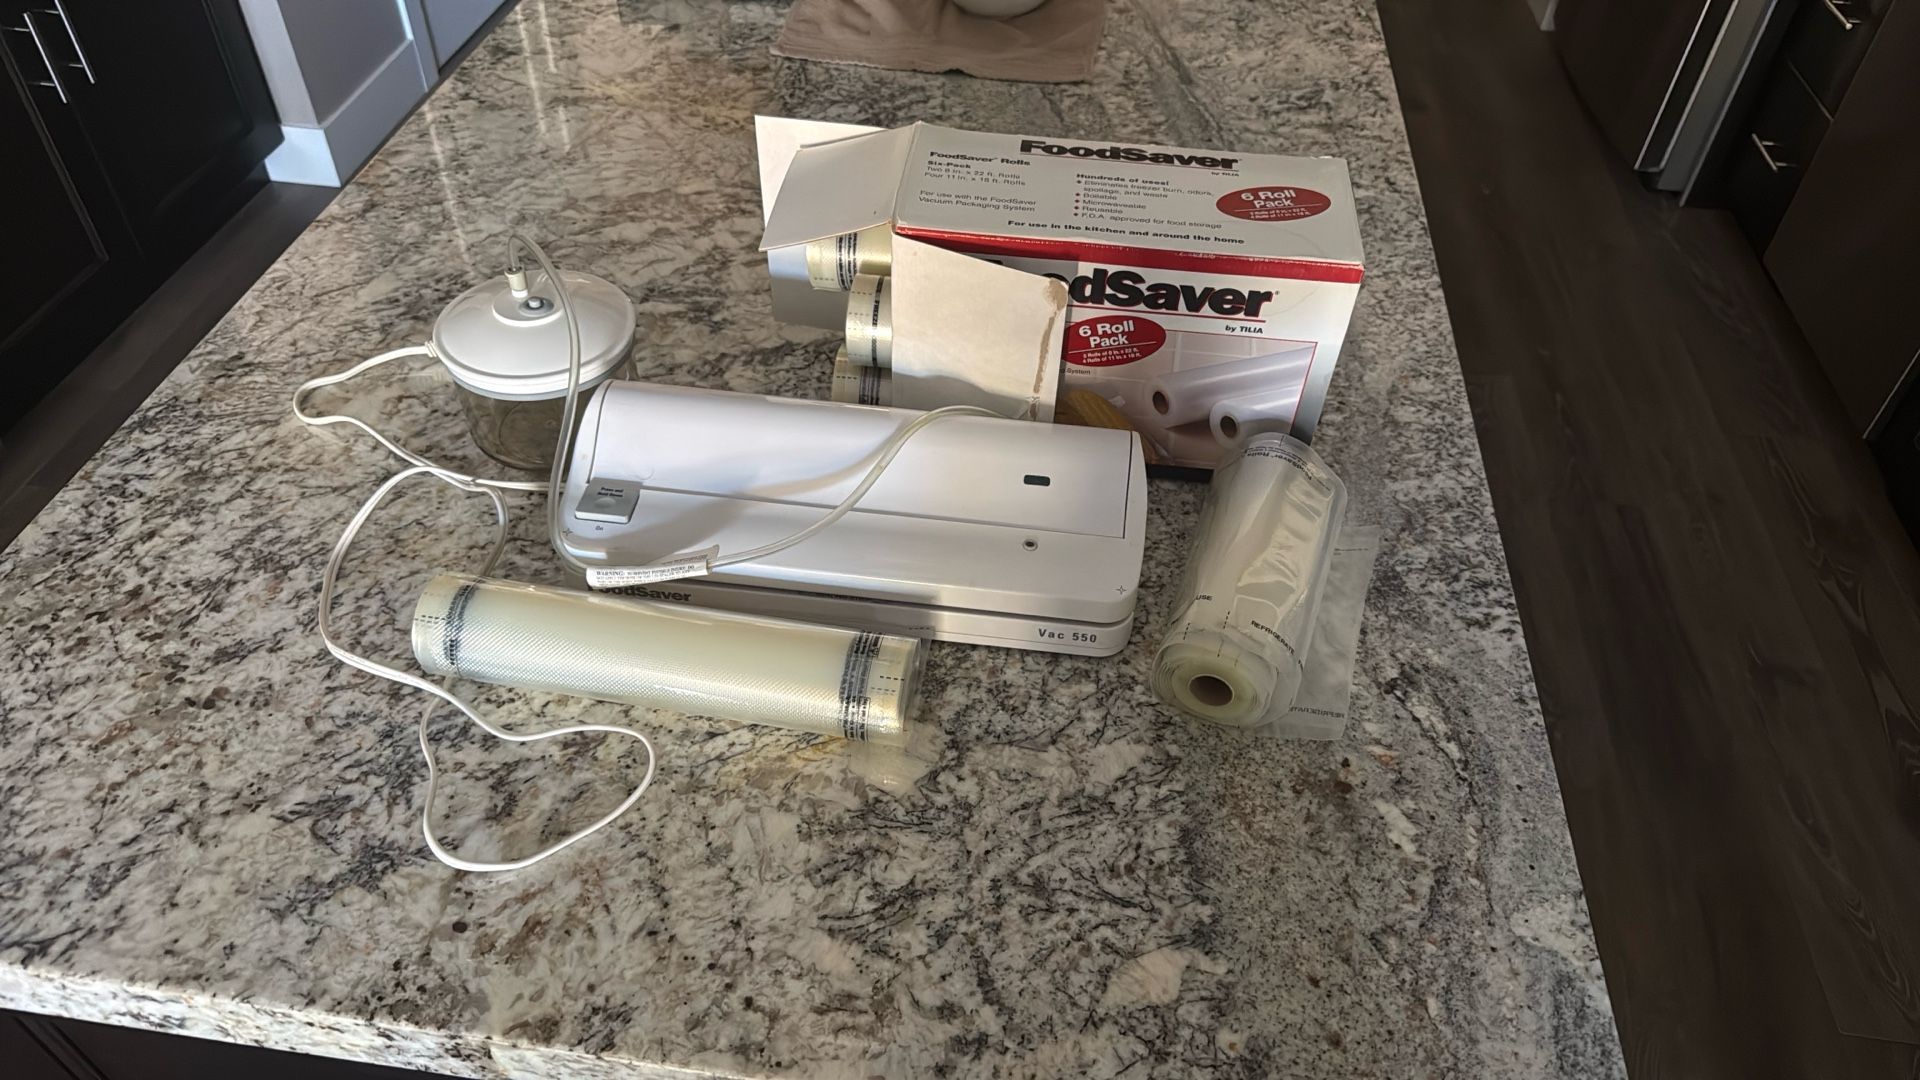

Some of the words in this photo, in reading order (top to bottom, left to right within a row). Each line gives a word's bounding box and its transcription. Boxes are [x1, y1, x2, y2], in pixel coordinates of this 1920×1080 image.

[1020, 140, 1239, 169] FoodSaver
[928, 160, 971, 169] Six-Pack
[1001, 158, 1031, 166] Rolls
[1076, 173, 1126, 182] Hundreds
[954, 192, 972, 200] with
[990, 196, 1036, 205] FoodSaver
[1241, 192, 1254, 201] 6
[1258, 189, 1297, 200] Roll
[918, 196, 953, 205] Vacuum
[955, 200, 1000, 210] Packaging
[1002, 204, 1036, 212] System
[1253, 198, 1295, 209] Pack
[1109, 215, 1151, 224] approved
[1085, 226, 1126, 235] kitchen
[1128, 229, 1149, 237] and
[1152, 231, 1190, 240] around
[1193, 234, 1211, 242] the
[1214, 236, 1245, 244] home
[1079, 325, 1092, 337] 6
[1096, 320, 1135, 335] Roll
[1225, 324, 1237, 333] by
[1239, 325, 1263, 335] TILIA
[1089, 334, 1129, 348] Pack
[1038, 628, 1065, 640] Vac
[1072, 632, 1097, 643] 550
[1251, 620, 1295, 656] REFRIGERATE
